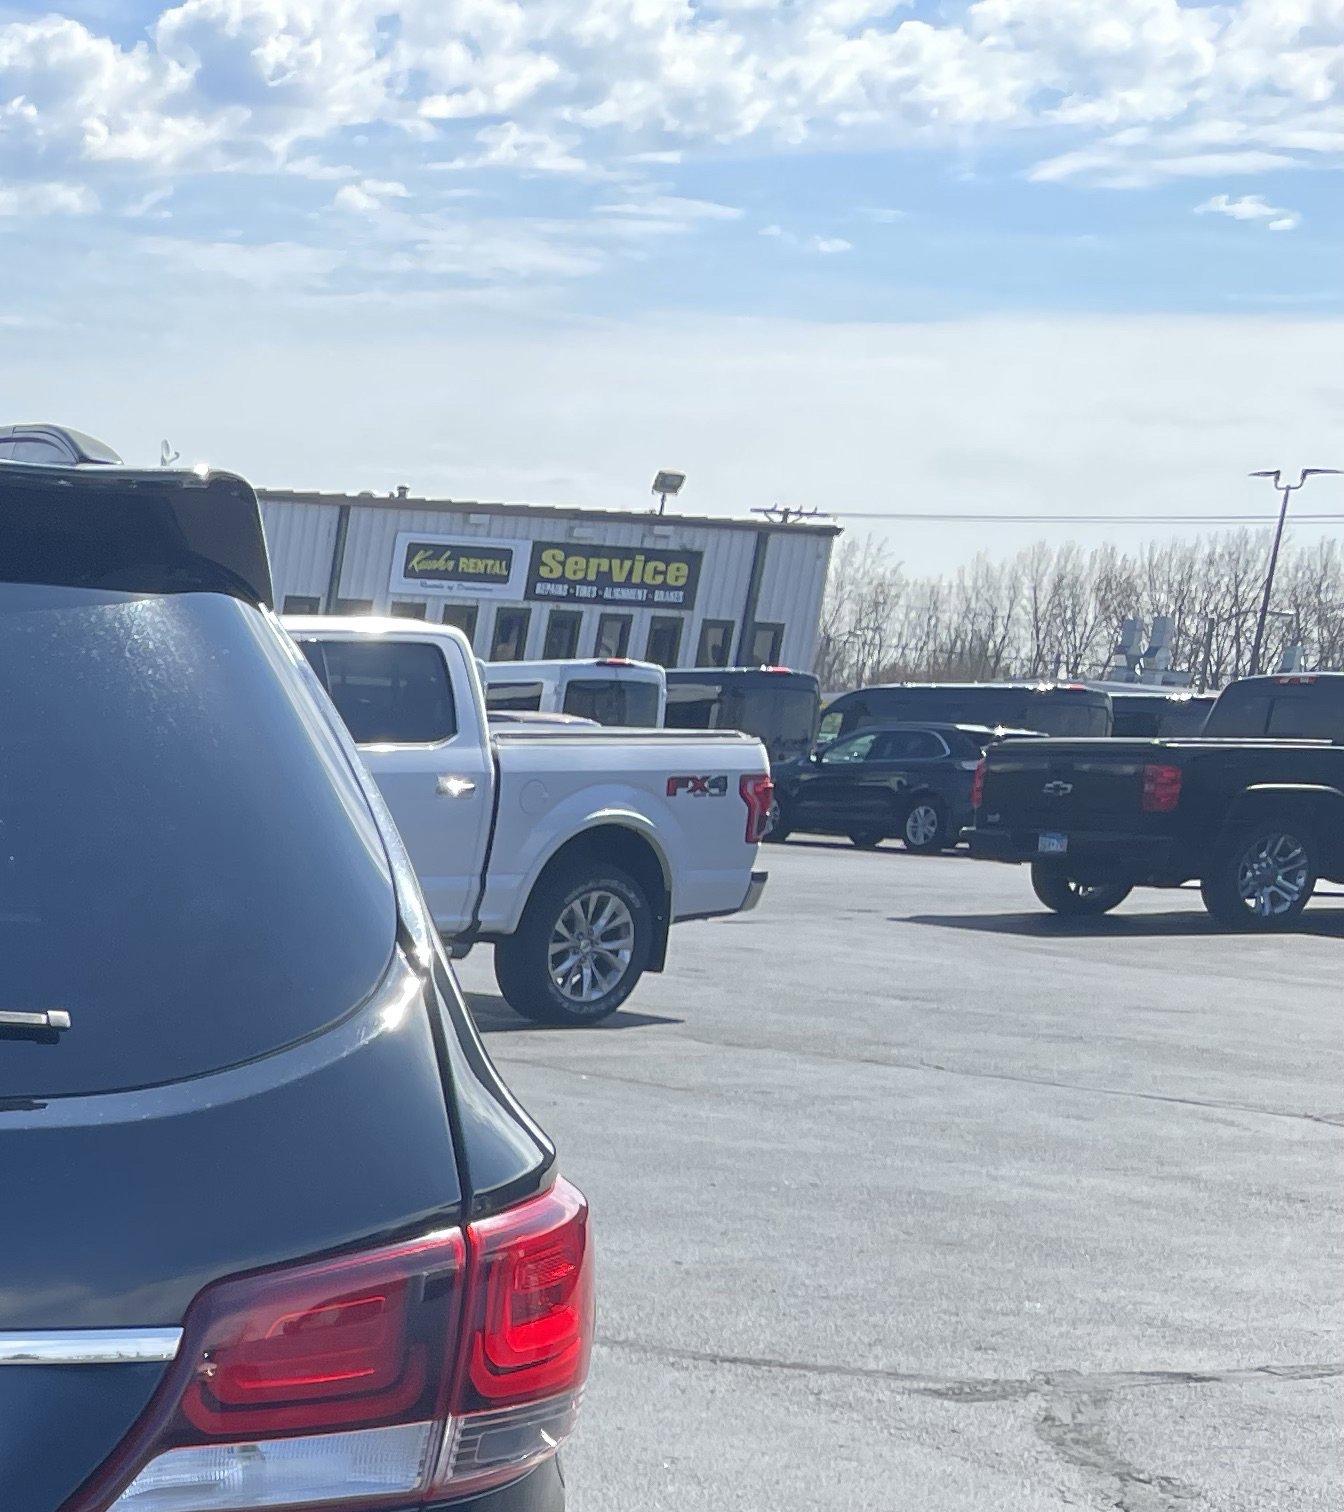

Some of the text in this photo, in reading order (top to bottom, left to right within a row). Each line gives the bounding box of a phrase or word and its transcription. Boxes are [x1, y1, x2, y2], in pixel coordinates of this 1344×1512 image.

[458, 557, 509, 576] RENTAL
[538, 549, 689, 586] Service
[666, 775, 728, 797] FX4
